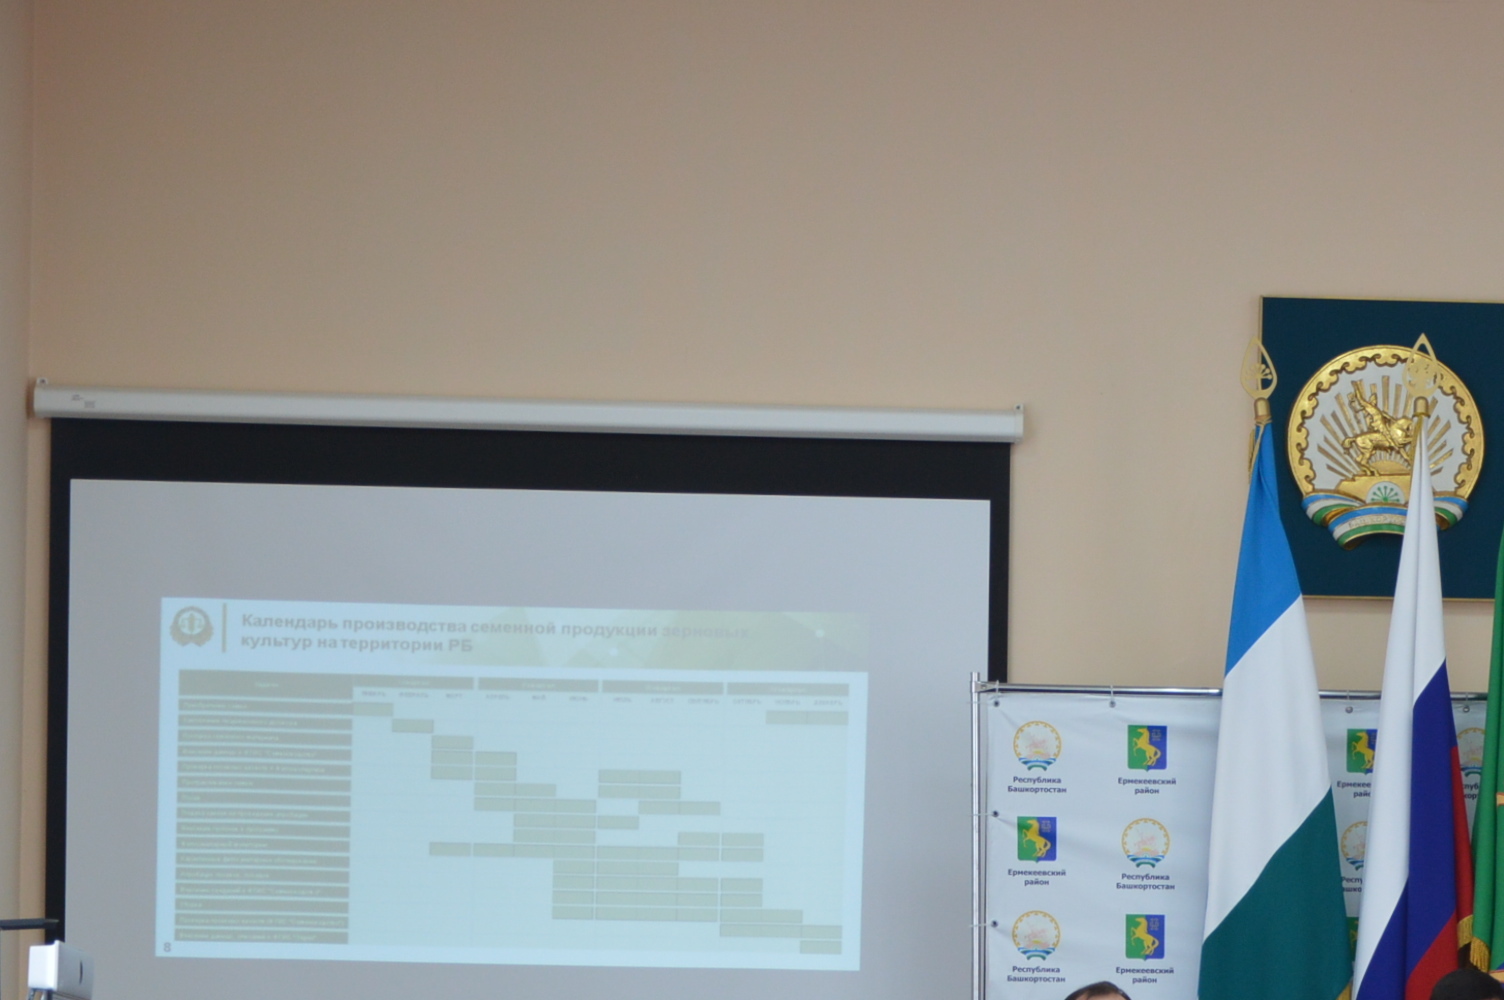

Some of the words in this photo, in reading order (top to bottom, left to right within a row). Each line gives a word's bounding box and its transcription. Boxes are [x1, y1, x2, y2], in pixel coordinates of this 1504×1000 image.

[241, 612, 338, 631] Календарь
[342, 616, 467, 635] производства
[471, 619, 556, 635] семенной
[561, 622, 657, 640] продукции
[240, 634, 313, 652] культур
[317, 637, 337, 650] на
[339, 638, 443, 655] территории
[448, 638, 473, 653] РБ
[1012, 775, 1062, 785] Республика
[1117, 776, 1177, 786] Ермекеевский
[1007, 785, 1068, 795] Башкортостан
[1134, 786, 1160, 796] район
[1007, 868, 1067, 878] Ермекеевский
[1121, 872, 1171, 882] Республика
[1023, 877, 1050, 887] район
[1115, 881, 1176, 892] Башкортостан
[163, 942, 172, 953] 8
[1011, 965, 1061, 975] Республика
[1115, 966, 1175, 976] Ермекеевский
[1006, 974, 1066, 984] Башкортостан
[1131, 975, 1158, 985] район
